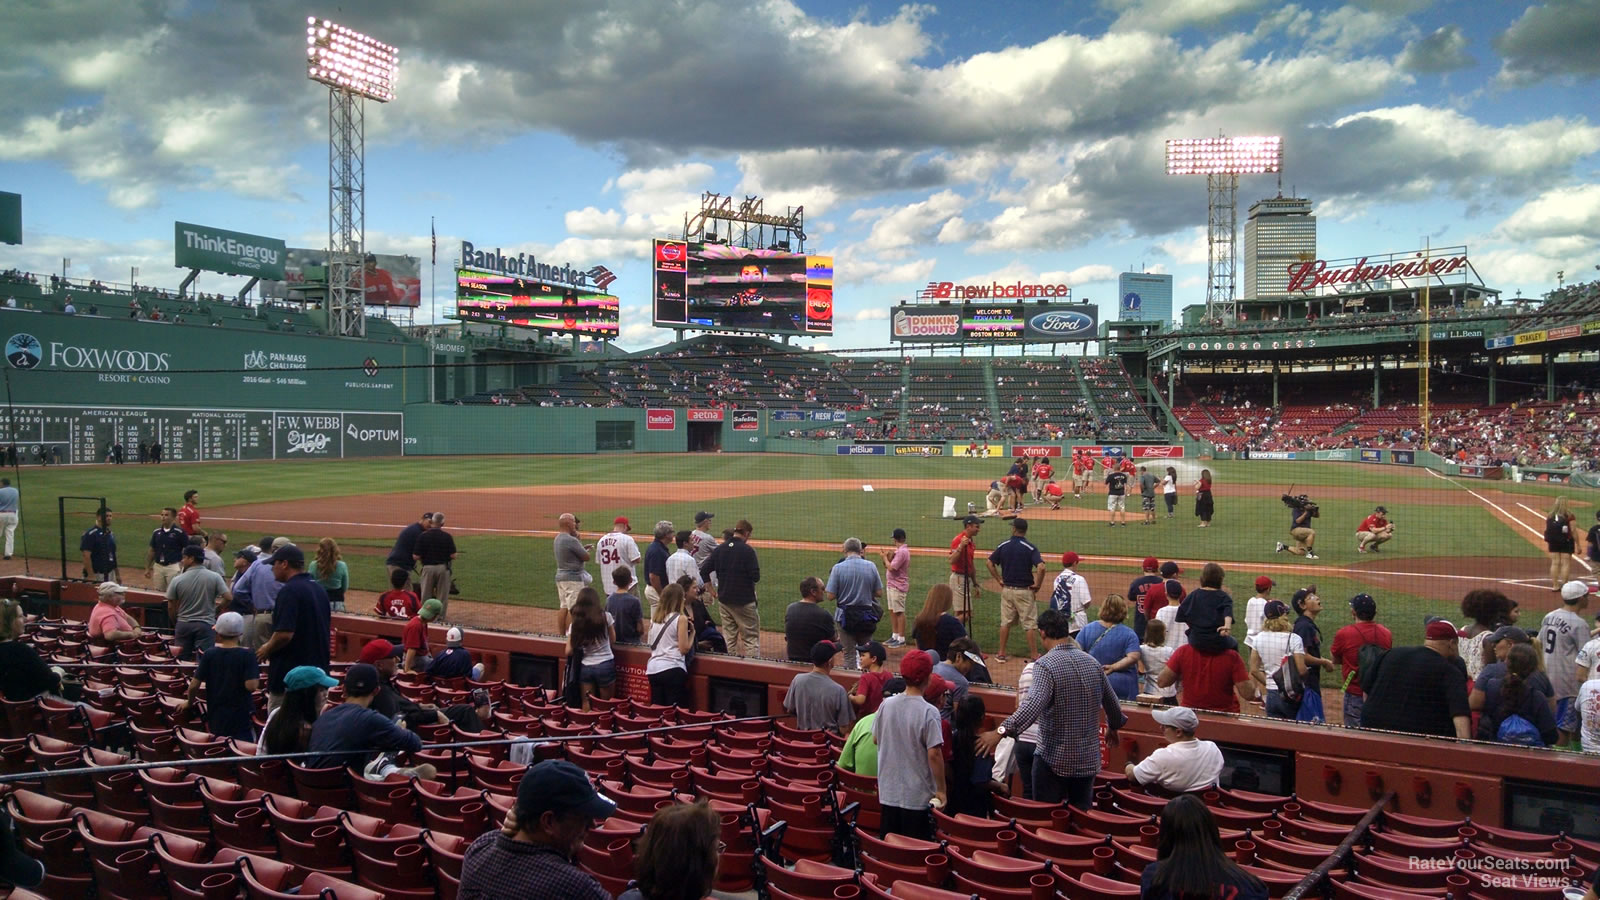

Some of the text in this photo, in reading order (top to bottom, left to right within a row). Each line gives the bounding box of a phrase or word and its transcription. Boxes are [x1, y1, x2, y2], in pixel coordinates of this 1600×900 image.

[183, 230, 278, 265] ThinkEnergy
[462, 240, 586, 287] Bank of America
[1286, 253, 1468, 293] Budweiser
[955, 281, 1068, 299] new balance
[913, 315, 958, 326] DUNKIN'
[1042, 315, 1080, 332] Ford
[913, 325, 957, 335] DONUTS
[1450, 330, 1482, 338] L.L.Bean
[1520, 333, 1543, 342] STANLEY
[50, 342, 169, 371] FOXWOODS
[270, 353, 307, 363] PAN-MASS
[99, 374, 170, 384] RESORT CASINO
[693, 411, 718, 419] aetna
[277, 416, 340, 429] F.W. WEBB
[359, 430, 399, 441] OPTUM
[849, 446, 874, 455] jetBlue
[1023, 447, 1050, 457] xfinity
[601, 539, 617, 549] ORTIZ
[602, 549, 621, 565] 34
[1545, 629, 1556, 654] 9
